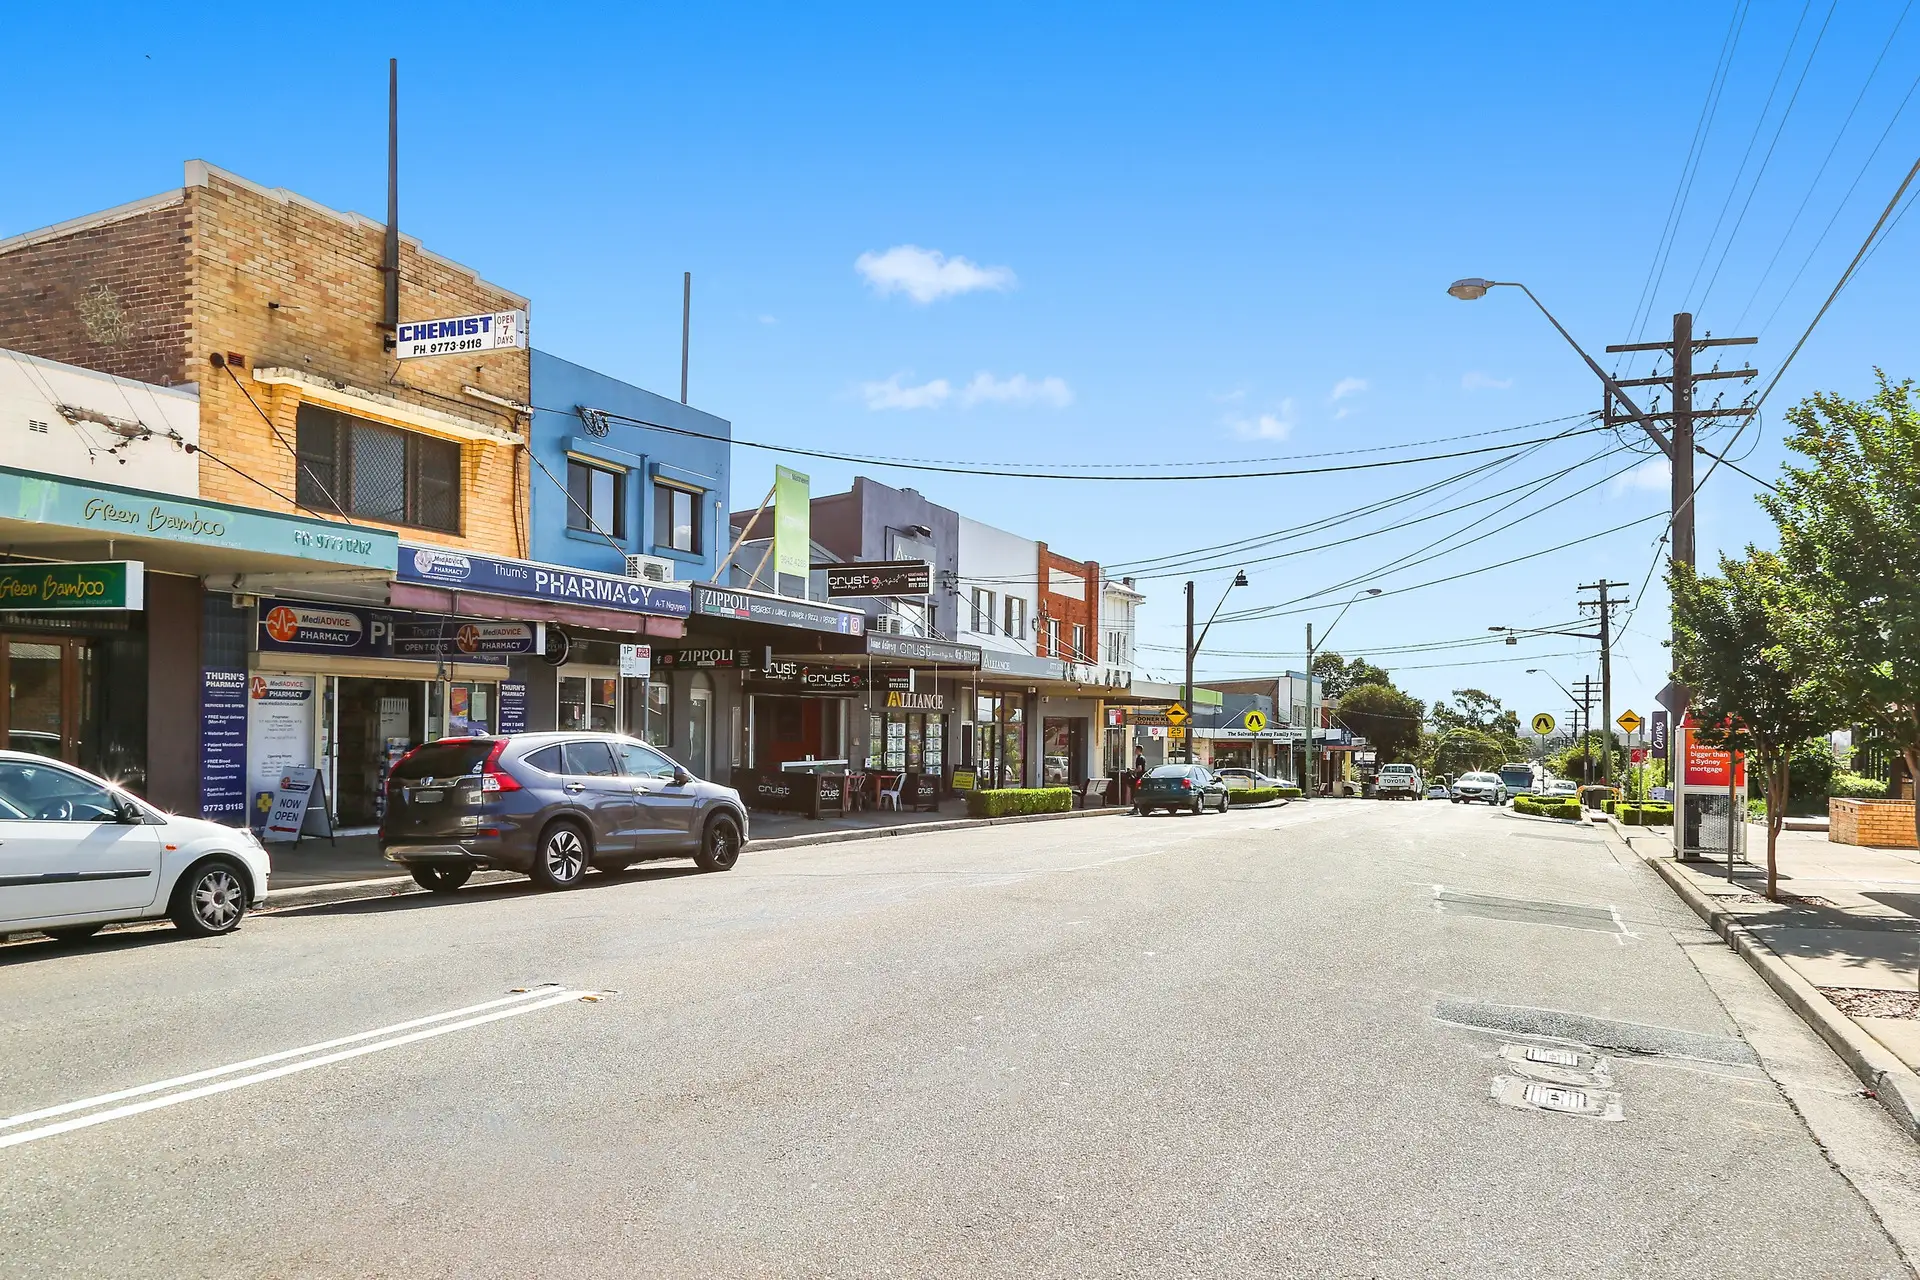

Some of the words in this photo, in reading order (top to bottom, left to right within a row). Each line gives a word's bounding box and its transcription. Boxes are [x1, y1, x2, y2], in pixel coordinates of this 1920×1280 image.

[497, 315, 514, 324] OPEN
[399, 316, 492, 342] CHEMIST
[503, 326, 508, 335] 7
[497, 336, 513, 344] DAYS
[414, 345, 427, 354] PH.
[430, 339, 482, 352] 9773-9118
[84, 498, 139, 524] Green
[148, 506, 225, 536] Bamboo
[316, 534, 343, 551] 9773
[434, 566, 463, 575] PHARMACY
[829, 575, 869, 585] crust
[0, 577, 37, 598] Green
[42, 574, 104, 600] Bamboo
[535, 570, 653, 605] PHARMACY
[666, 601, 686, 612] Nguyen
[705, 590, 749, 610] ZIPPOLI
[301, 615, 350, 626] MediADVICE
[300, 631, 349, 642] PHARMACY
[900, 642, 931, 656] crust
[679, 649, 733, 662] ZIPPOLI
[205, 672, 245, 680] THURN'S
[808, 673, 850, 683] crust
[887, 691, 944, 709] ALLIANCE
[1653, 721, 1664, 750] Curves
[758, 784, 790, 795] crust
[820, 789, 840, 797] crust
[280, 799, 301, 809] NOW
[275, 811, 299, 822] OPEN
